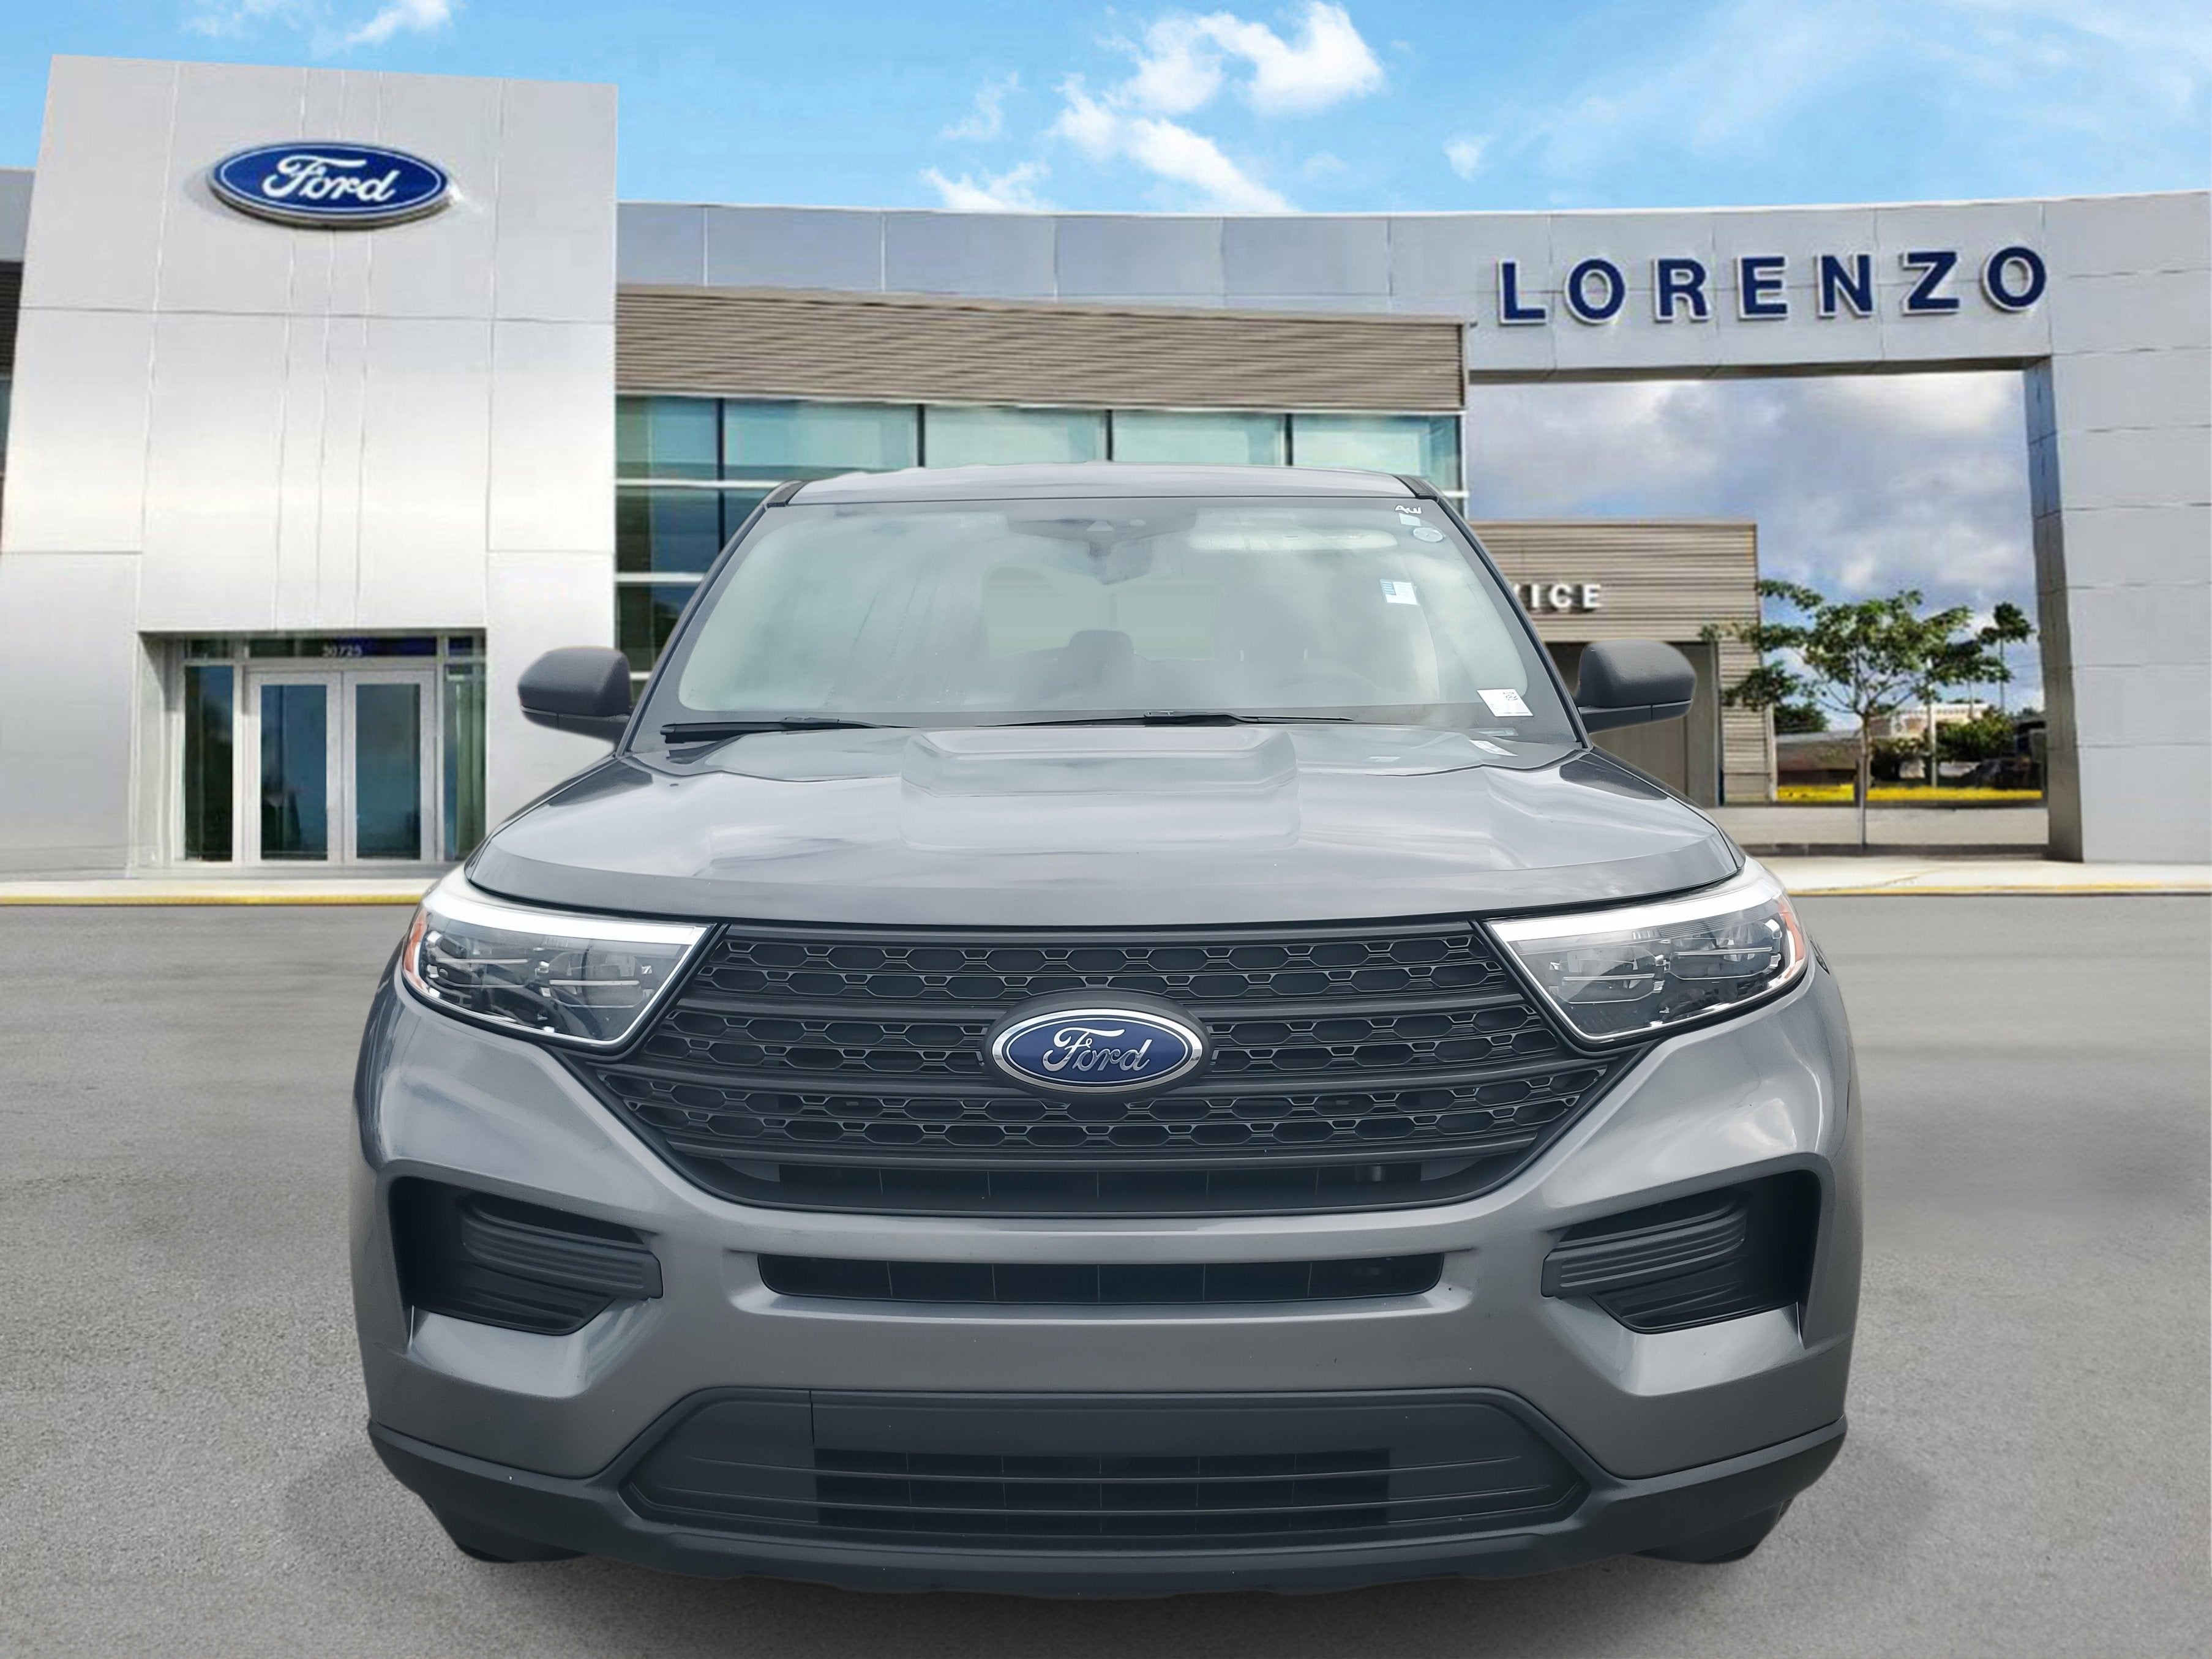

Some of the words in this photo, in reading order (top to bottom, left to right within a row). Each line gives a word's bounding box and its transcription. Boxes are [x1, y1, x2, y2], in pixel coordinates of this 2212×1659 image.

[261, 155, 400, 201] Ford
[1498, 245, 2046, 323] LORENZO
[1043, 1027, 1152, 1071] Ford
